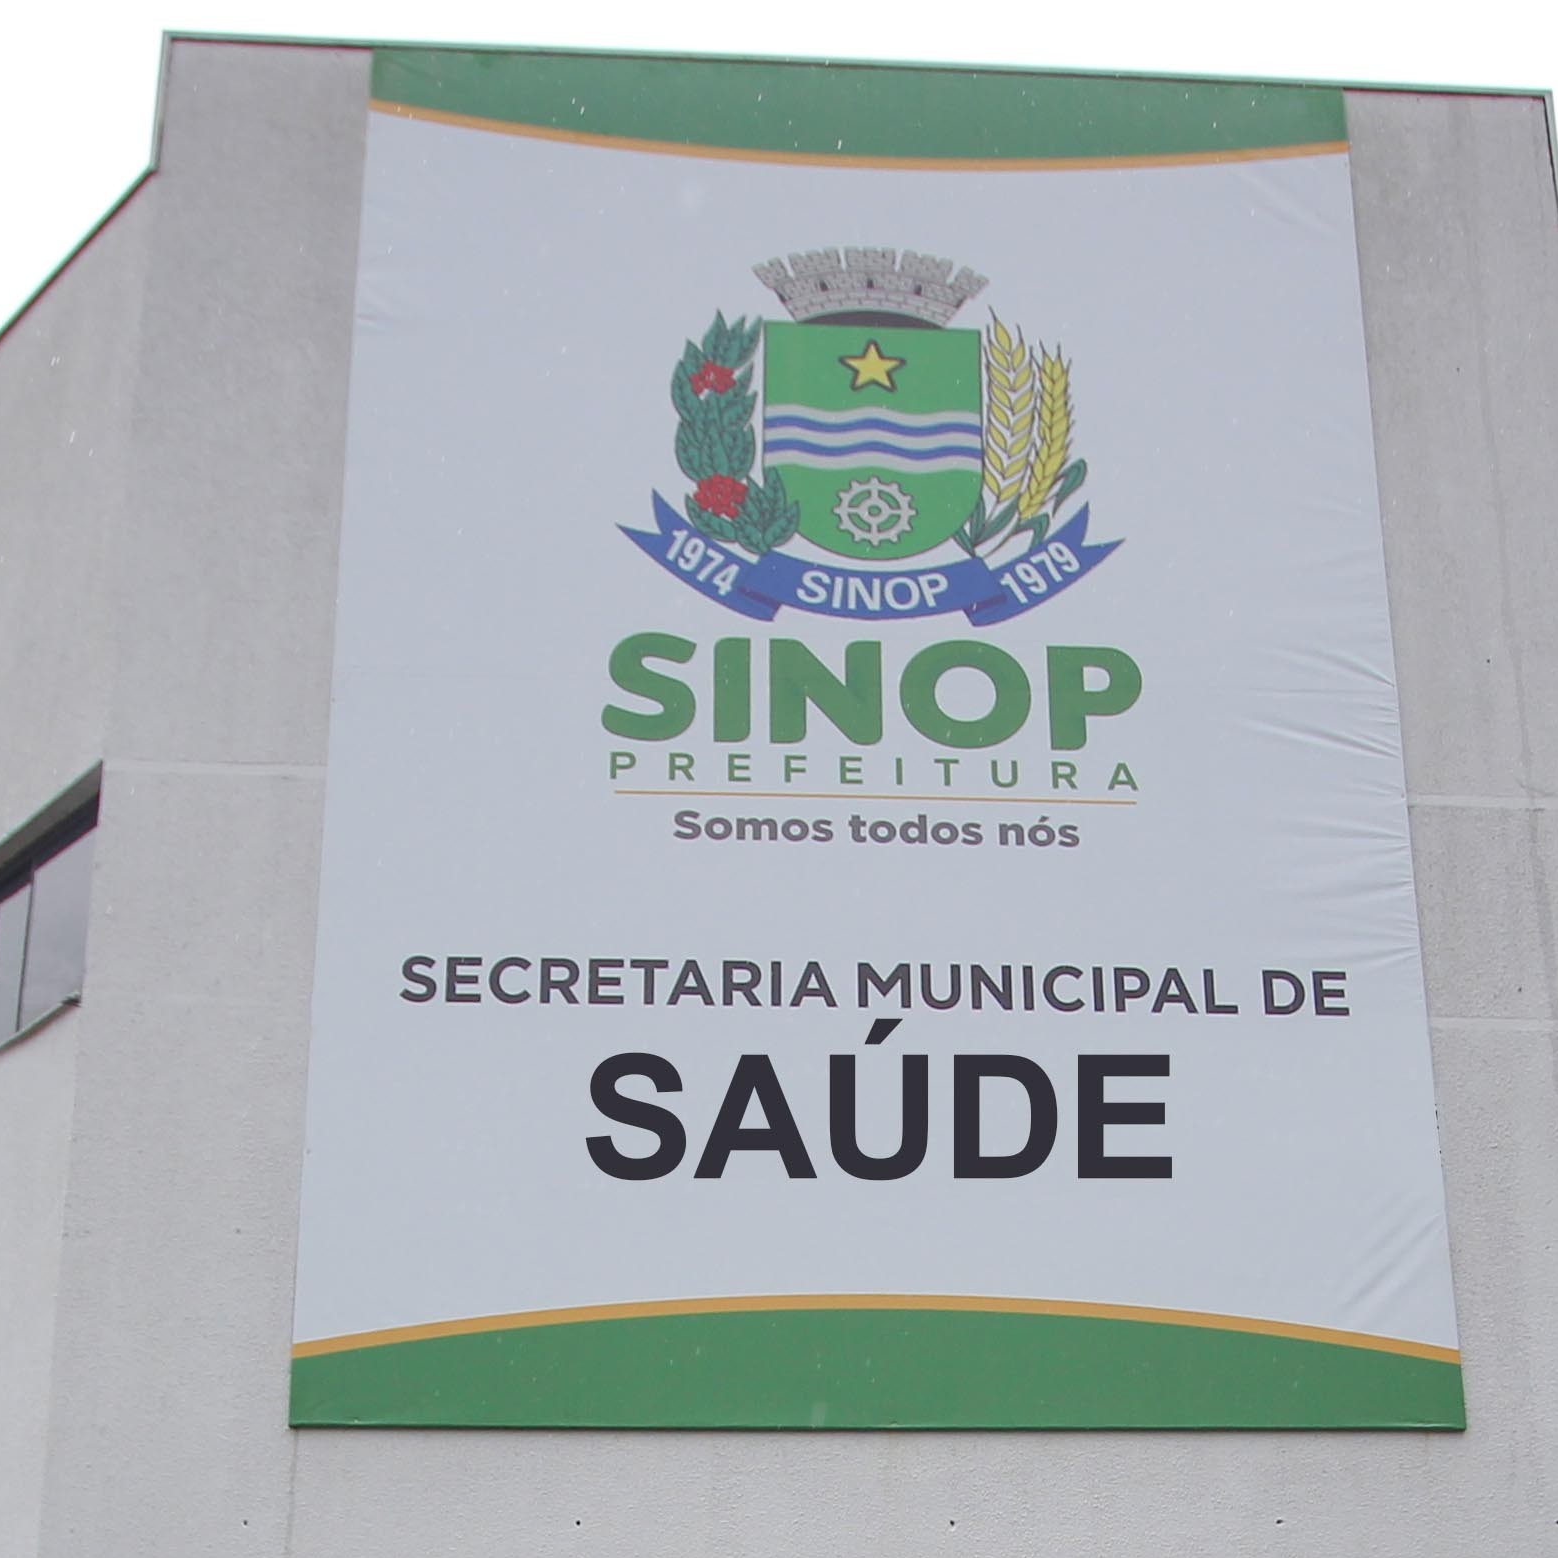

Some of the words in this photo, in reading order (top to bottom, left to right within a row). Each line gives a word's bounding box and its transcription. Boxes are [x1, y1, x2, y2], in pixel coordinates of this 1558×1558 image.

[666, 528, 740, 597] 1974
[796, 570, 950, 611] SINOP
[999, 541, 1083, 604] 1979
[600, 630, 1144, 752] SINOP
[609, 750, 1139, 792] PREFEITURA
[673, 810, 834, 843] Somos
[848, 813, 984, 846] todos
[998, 815, 1081, 848] nós
[399, 955, 838, 1010] SECRETARIA
[857, 961, 1239, 1015] MUNICIPAL
[1261, 969, 1351, 1017] DE
[585, 1018, 1173, 1181] SAÚDE
